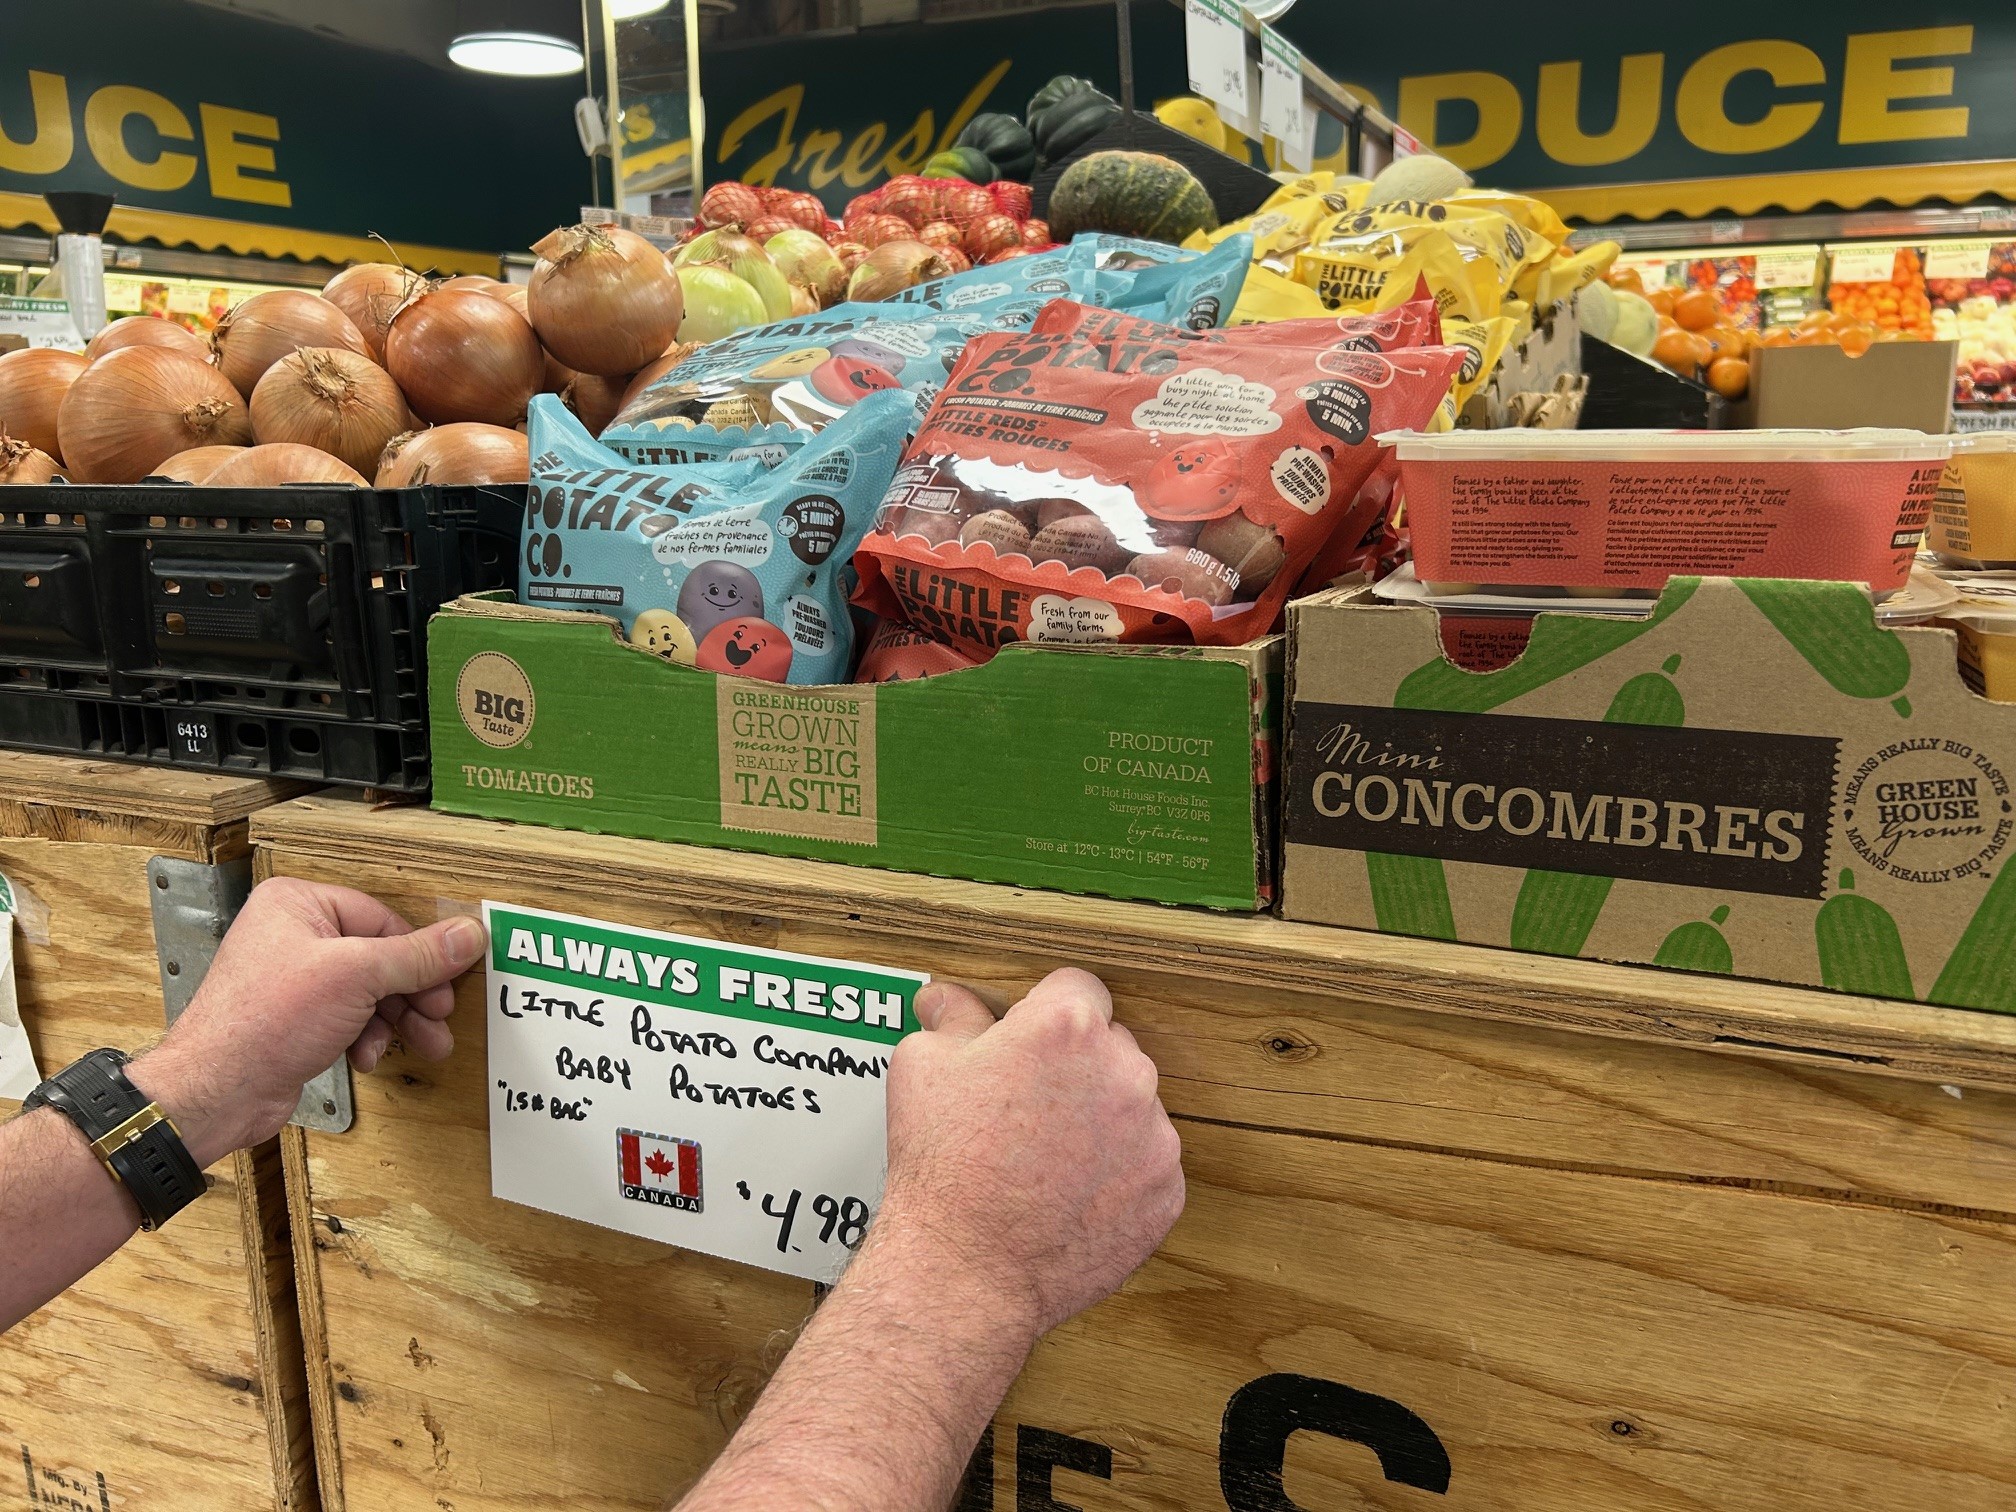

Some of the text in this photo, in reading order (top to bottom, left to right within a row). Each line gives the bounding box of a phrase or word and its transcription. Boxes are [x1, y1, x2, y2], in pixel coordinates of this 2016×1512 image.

[1358, 200, 1447, 223] TATO
[977, 342, 1179, 376] POTATO
[957, 367, 1035, 396] CO.
[1174, 376, 1183, 385] A
[1186, 376, 1213, 388] little
[1238, 384, 1255, 394] for
[1162, 397, 1180, 409] Une
[1214, 404, 1254, 415] solution
[1166, 385, 1188, 398] busy
[1191, 387, 1219, 400] night
[1238, 393, 1266, 404] home
[1322, 386, 1359, 409] 5 MINS
[931, 410, 986, 423] LITTLE
[1000, 400, 1033, 411] POMMES
[1033, 403, 1045, 412] DE
[1045, 405, 1067, 416] TERRE
[1139, 407, 1269, 426] gagnante pour les soirées
[1216, 424, 1248, 433] maison
[1321, 408, 1352, 434] 5 MIN.
[988, 428, 1072, 452] ROUGES
[1290, 457, 1325, 497] PRE-WASHED
[1302, 455, 1327, 484] ALWAYS
[1276, 475, 1310, 505] PRÉLAVÉES
[1283, 468, 1316, 499] TOUJOURS
[1452, 487, 1578, 496] the family bond has been the
[527, 485, 679, 539] POTATO
[1451, 496, 1591, 506] root The Little Potato Company
[1451, 507, 1470, 515] since
[725, 515, 752, 528] terre
[801, 511, 835, 527] 5 MINS
[664, 529, 769, 545] fraîches en provenance
[1057, 528, 1086, 538] Canada
[526, 532, 572, 578] CO.
[657, 541, 769, 555] de nos fermes familiales
[808, 540, 815, 553] 5
[1185, 547, 1209, 569] 680
[792, 609, 827, 629] PRE-WASHED
[797, 601, 820, 618] ALWAYS
[1041, 602, 1110, 621] Fresh from our
[795, 621, 824, 639] TOUJOURS
[1046, 617, 1104, 634] family farms
[793, 631, 825, 649] PRÉLAVÉES
[474, 688, 525, 725] BIG
[732, 691, 860, 716] GREENHOUSE
[177, 722, 208, 739] 6413
[482, 716, 515, 737] Taste
[732, 710, 860, 747] GROWN
[187, 739, 201, 753] LL
[732, 740, 800, 754] means
[1107, 731, 1213, 757] PRODUCT
[1315, 721, 1444, 770] Mini
[735, 746, 861, 779] REALLY BIG
[1083, 755, 1213, 784] OF CANADA
[1844, 738, 2010, 805] MEANS REALLY BIG TASTE
[462, 765, 594, 800] TOMATOES
[1876, 778, 1977, 803] GREEN
[734, 772, 862, 817] TASTE
[1084, 784, 1211, 808] BC Hot House Foods Inc.
[1146, 804, 1162, 816] BC
[1166, 807, 1188, 820] V3Z
[1311, 770, 1805, 863] CONCOMBRES
[1878, 800, 1980, 824] HOUSE
[1025, 837, 1054, 852] Store
[1056, 841, 1068, 853] at
[1873, 815, 1986, 858] Grown
[1845, 818, 2014, 883] MEANS REALLY BIG TASTE
[507, 927, 904, 1031] ALWAYS FRESH
[500, 984, 605, 1028] LITTLE
[630, 1004, 738, 1059] POTATO
[555, 1046, 822, 1114] BABY POTATOES
[625, 1186, 699, 1212] CANADA
